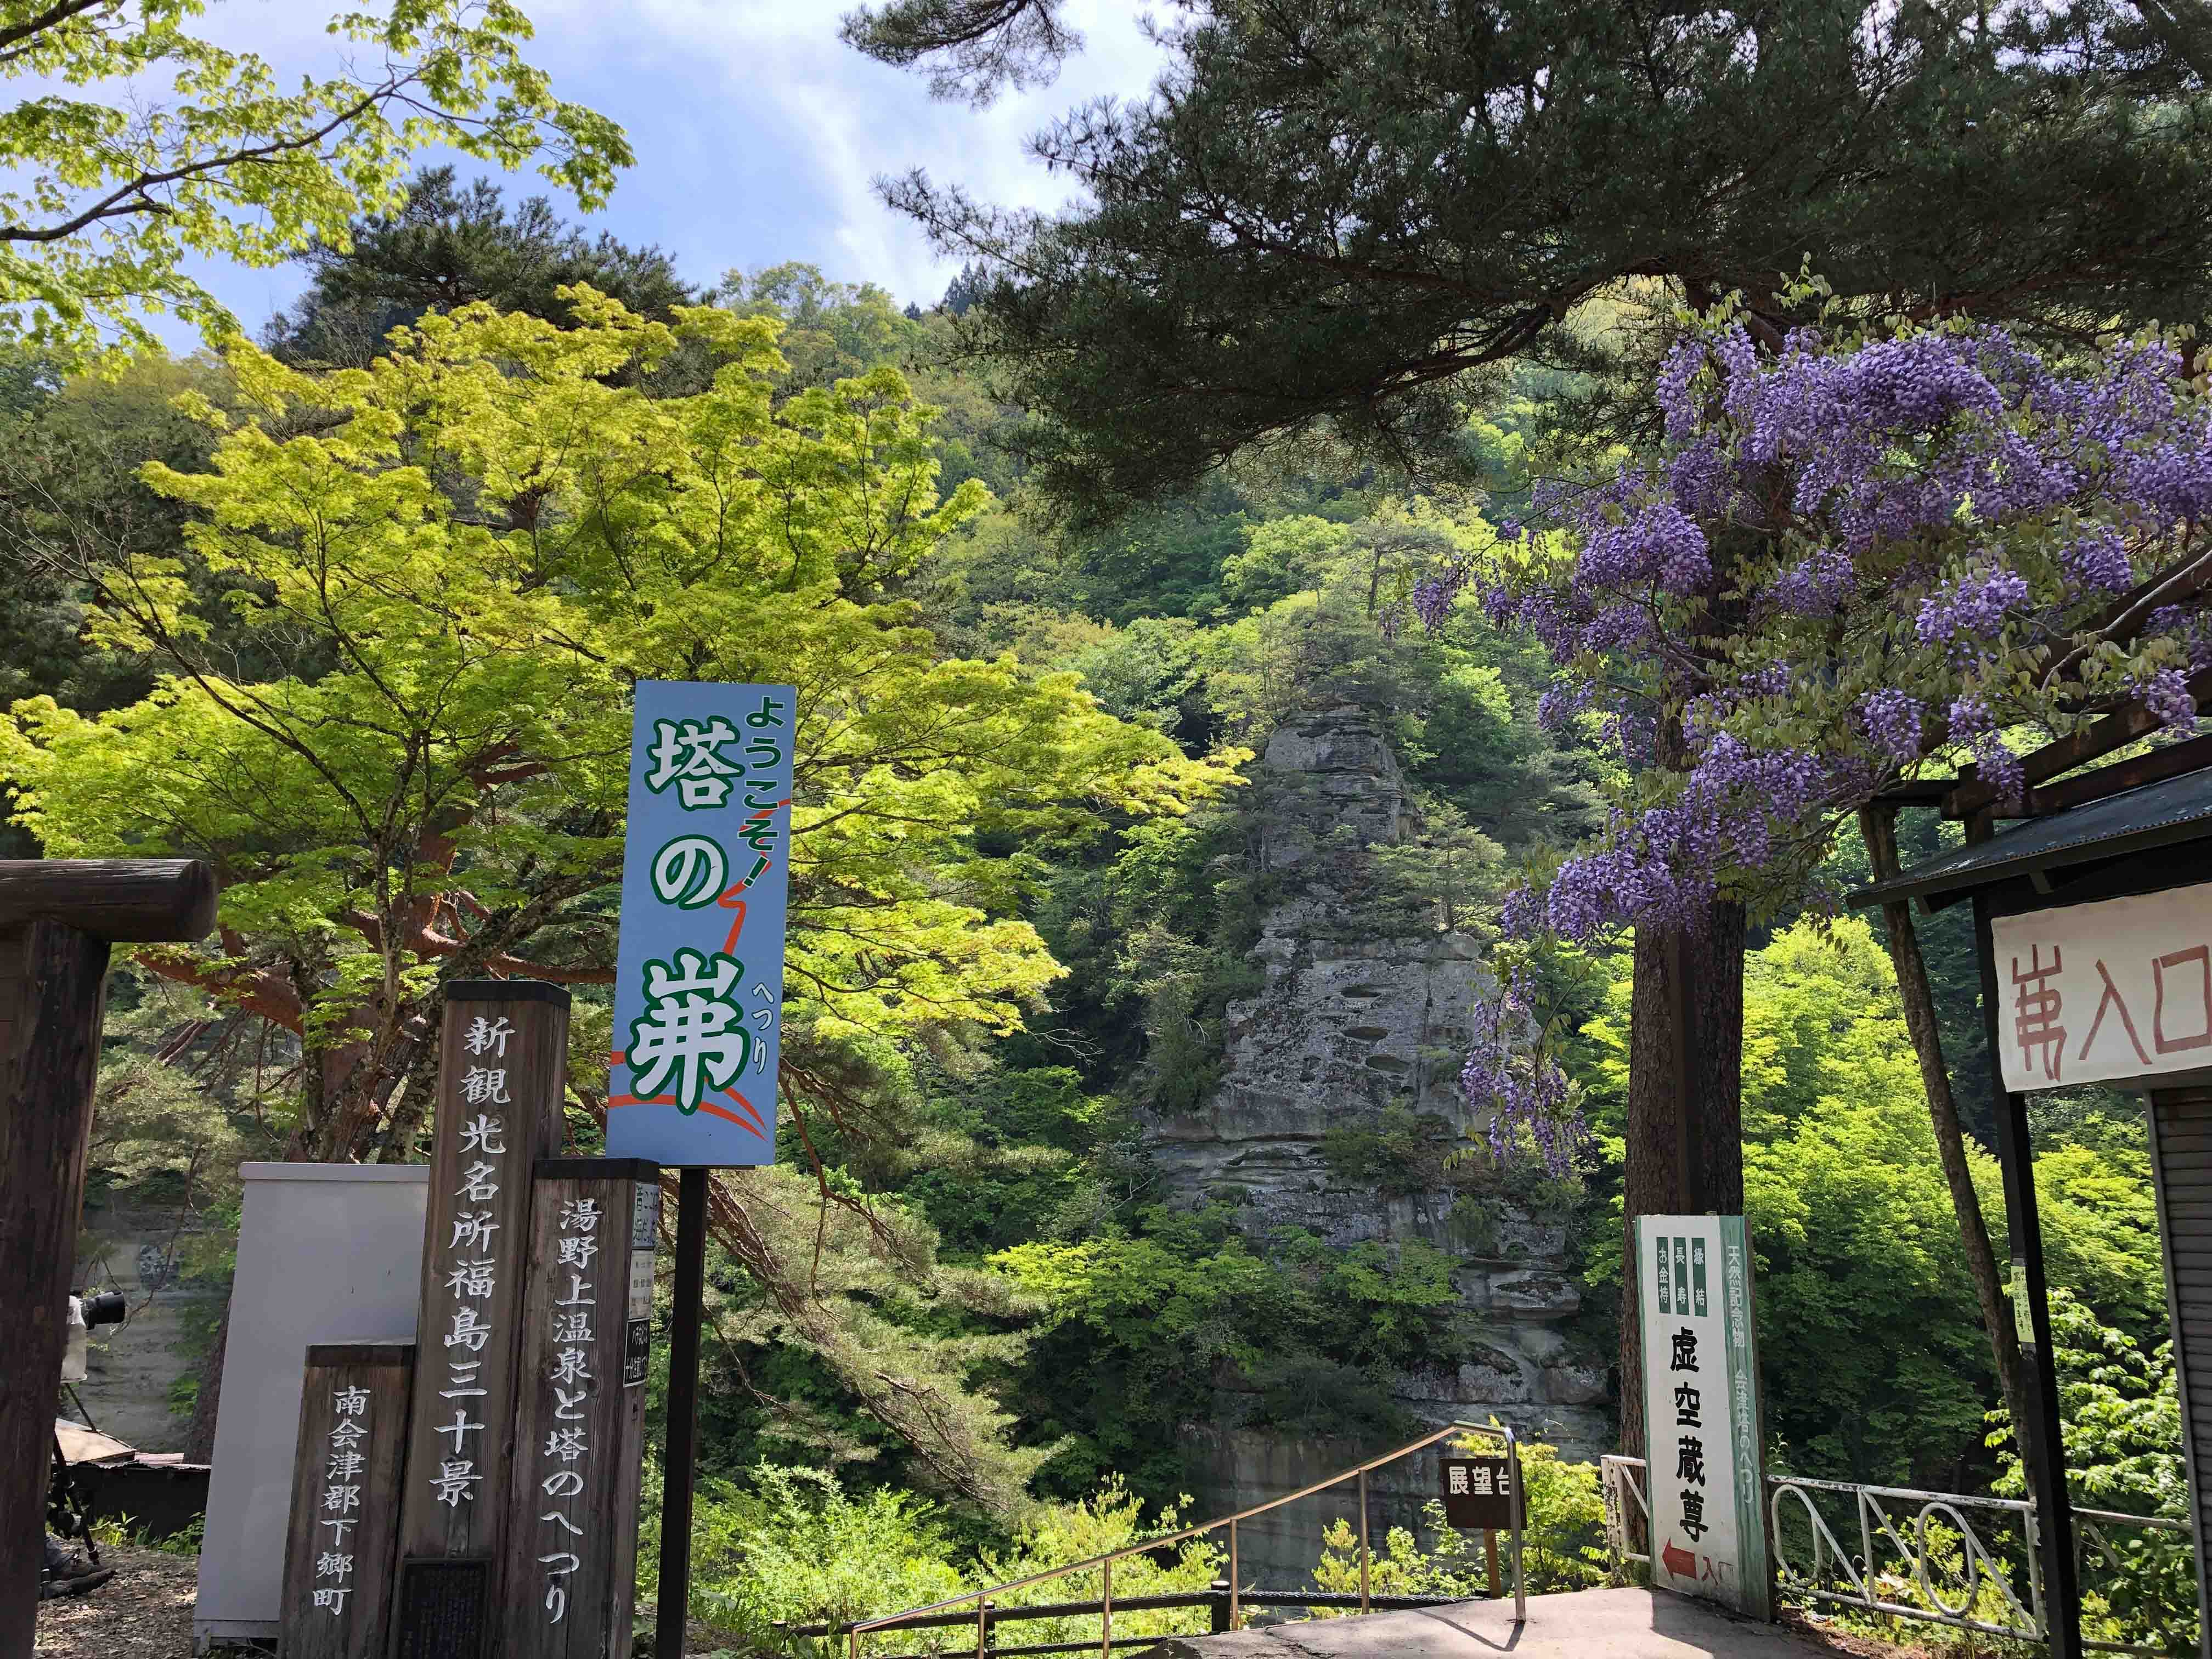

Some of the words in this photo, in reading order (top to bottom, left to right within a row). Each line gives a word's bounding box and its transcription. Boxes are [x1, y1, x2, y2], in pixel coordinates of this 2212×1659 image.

[737, 695, 786, 889] ようこそ!
[752, 982, 775, 1075] へつり
[428, 1016, 515, 1508] 新観光名所福島三十景
[1658, 1246, 1668, 1304] お金持
[1675, 1246, 1686, 1305] 長寿
[312, 1385, 370, 1616] 南会津郡下郷町
[538, 1198, 602, 1624] 湯野上温泉と塔のへつり
[1671, 1326, 1708, 1542] 虚空蔵尊
